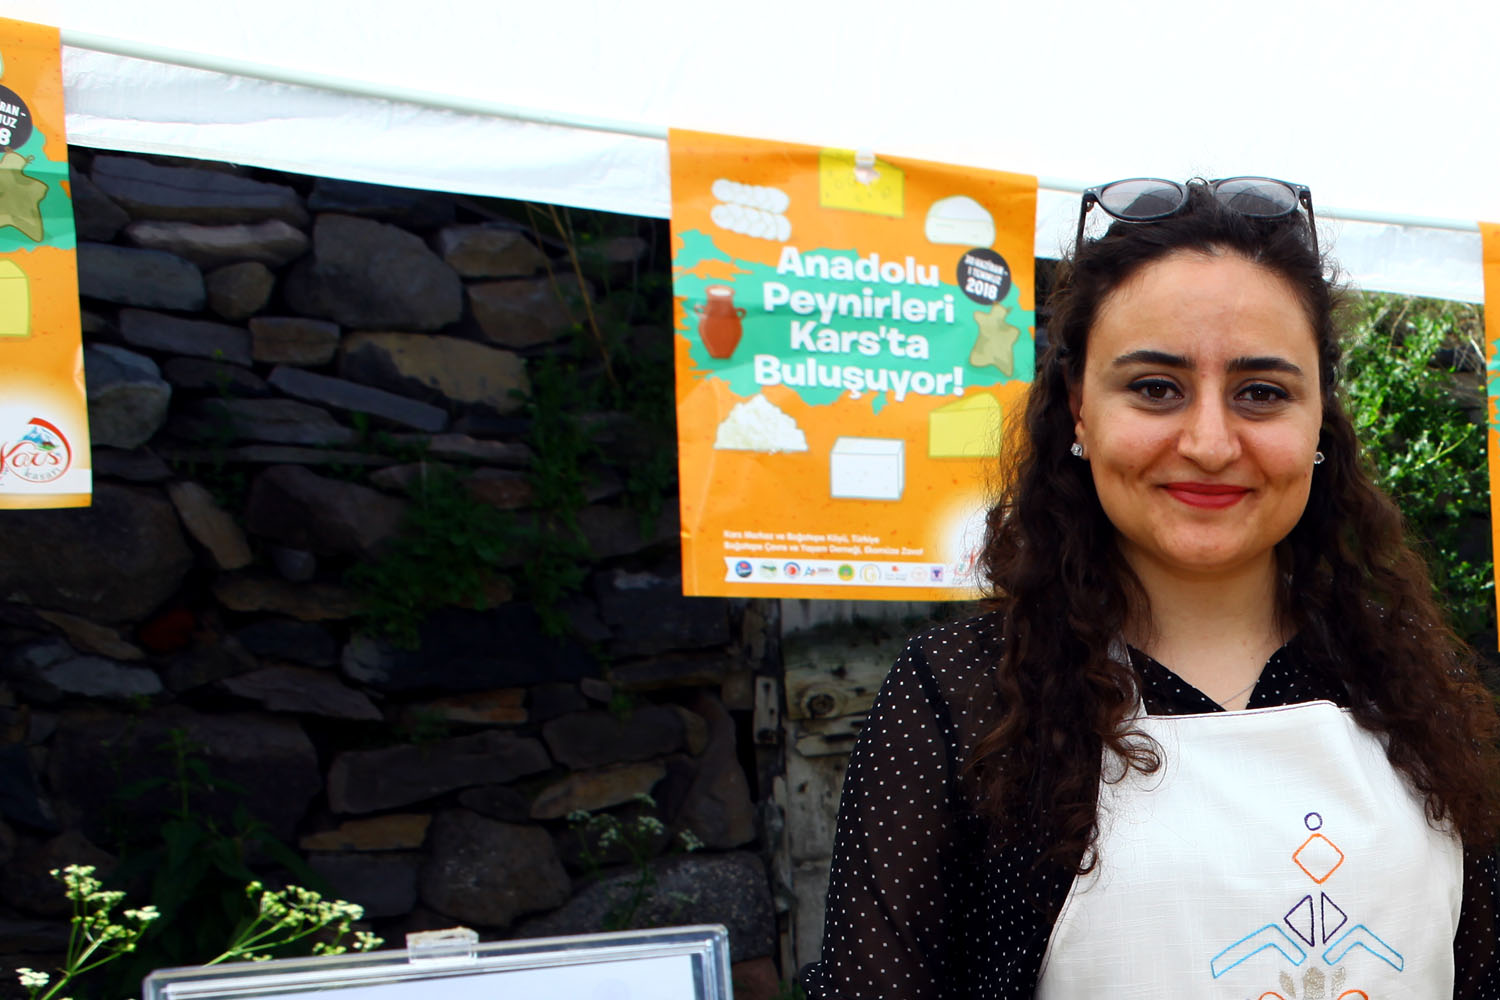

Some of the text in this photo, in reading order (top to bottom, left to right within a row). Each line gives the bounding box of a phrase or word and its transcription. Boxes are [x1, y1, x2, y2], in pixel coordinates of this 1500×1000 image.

[776, 246, 939, 287] Anadolu
[763, 281, 954, 324] Peynirleri
[965, 276, 998, 301] 2018
[790, 320, 929, 360] Kars'ta
[754, 354, 964, 402] Buluşuyor!
